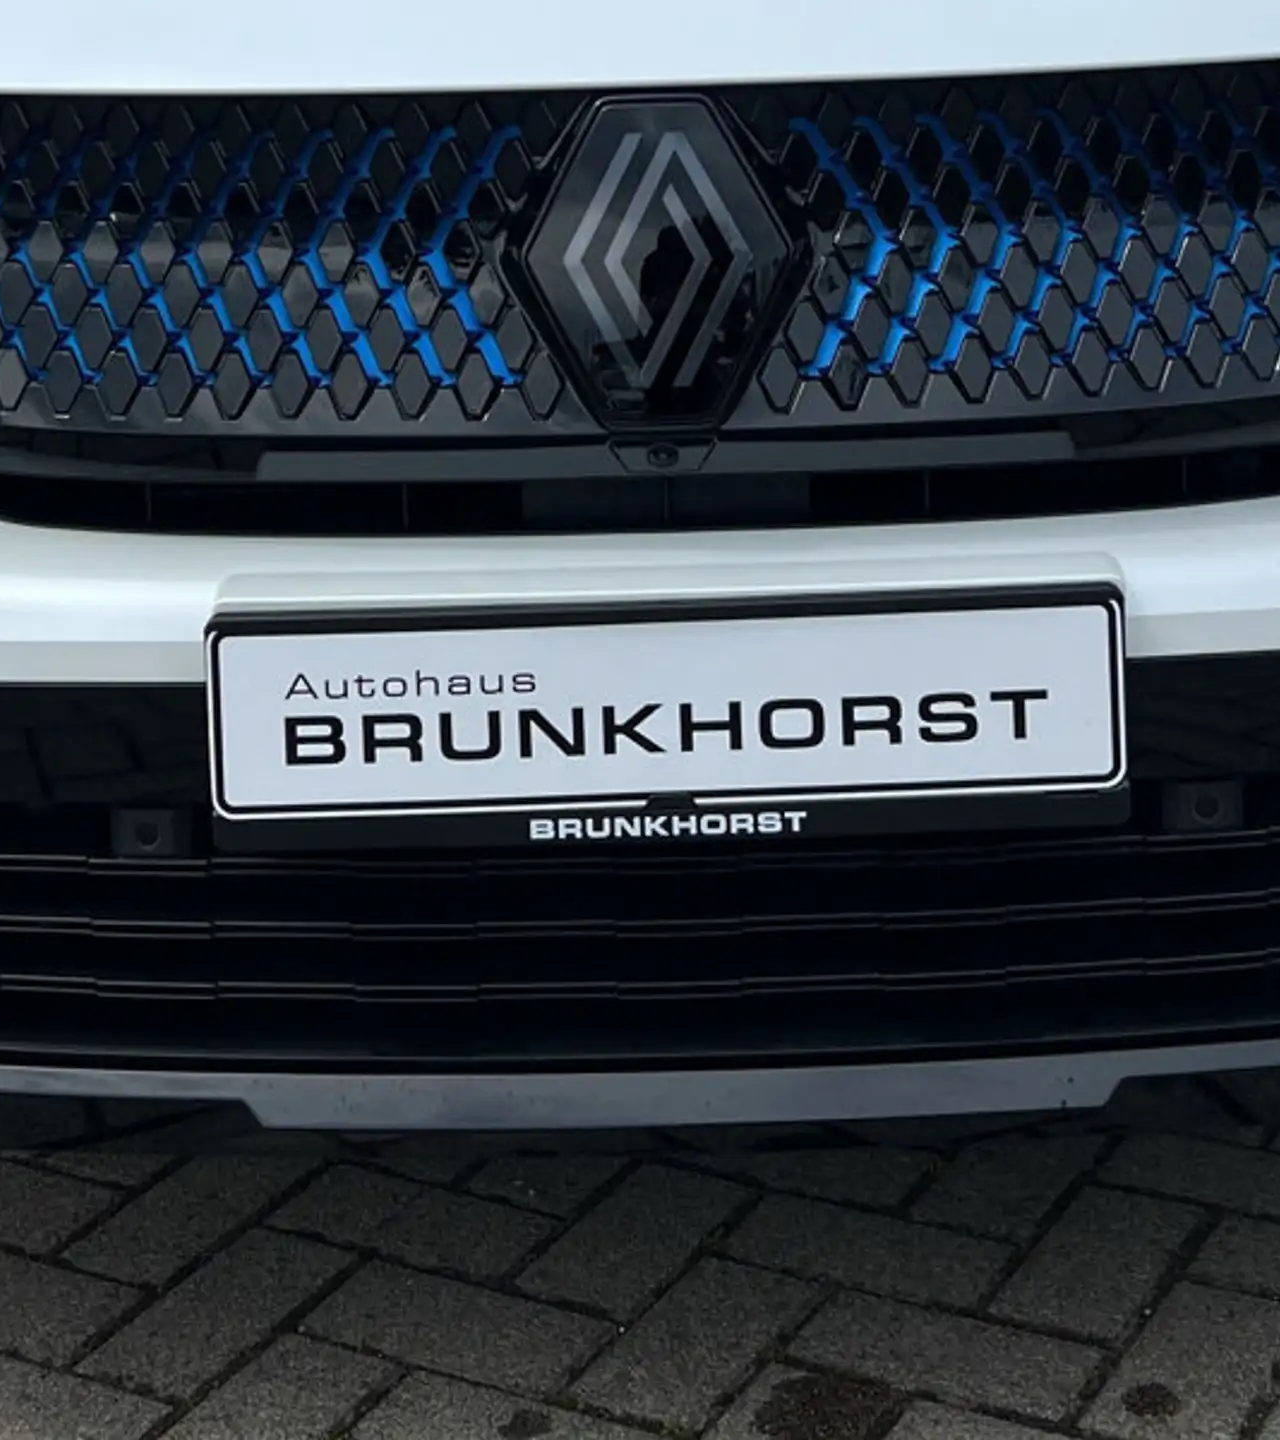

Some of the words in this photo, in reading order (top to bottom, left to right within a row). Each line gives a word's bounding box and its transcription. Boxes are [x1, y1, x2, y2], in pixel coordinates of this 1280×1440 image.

[283, 670, 537, 701] Autohaus
[283, 689, 1049, 767] BRUNKHORST
[528, 810, 809, 841] BRUNKHORST
